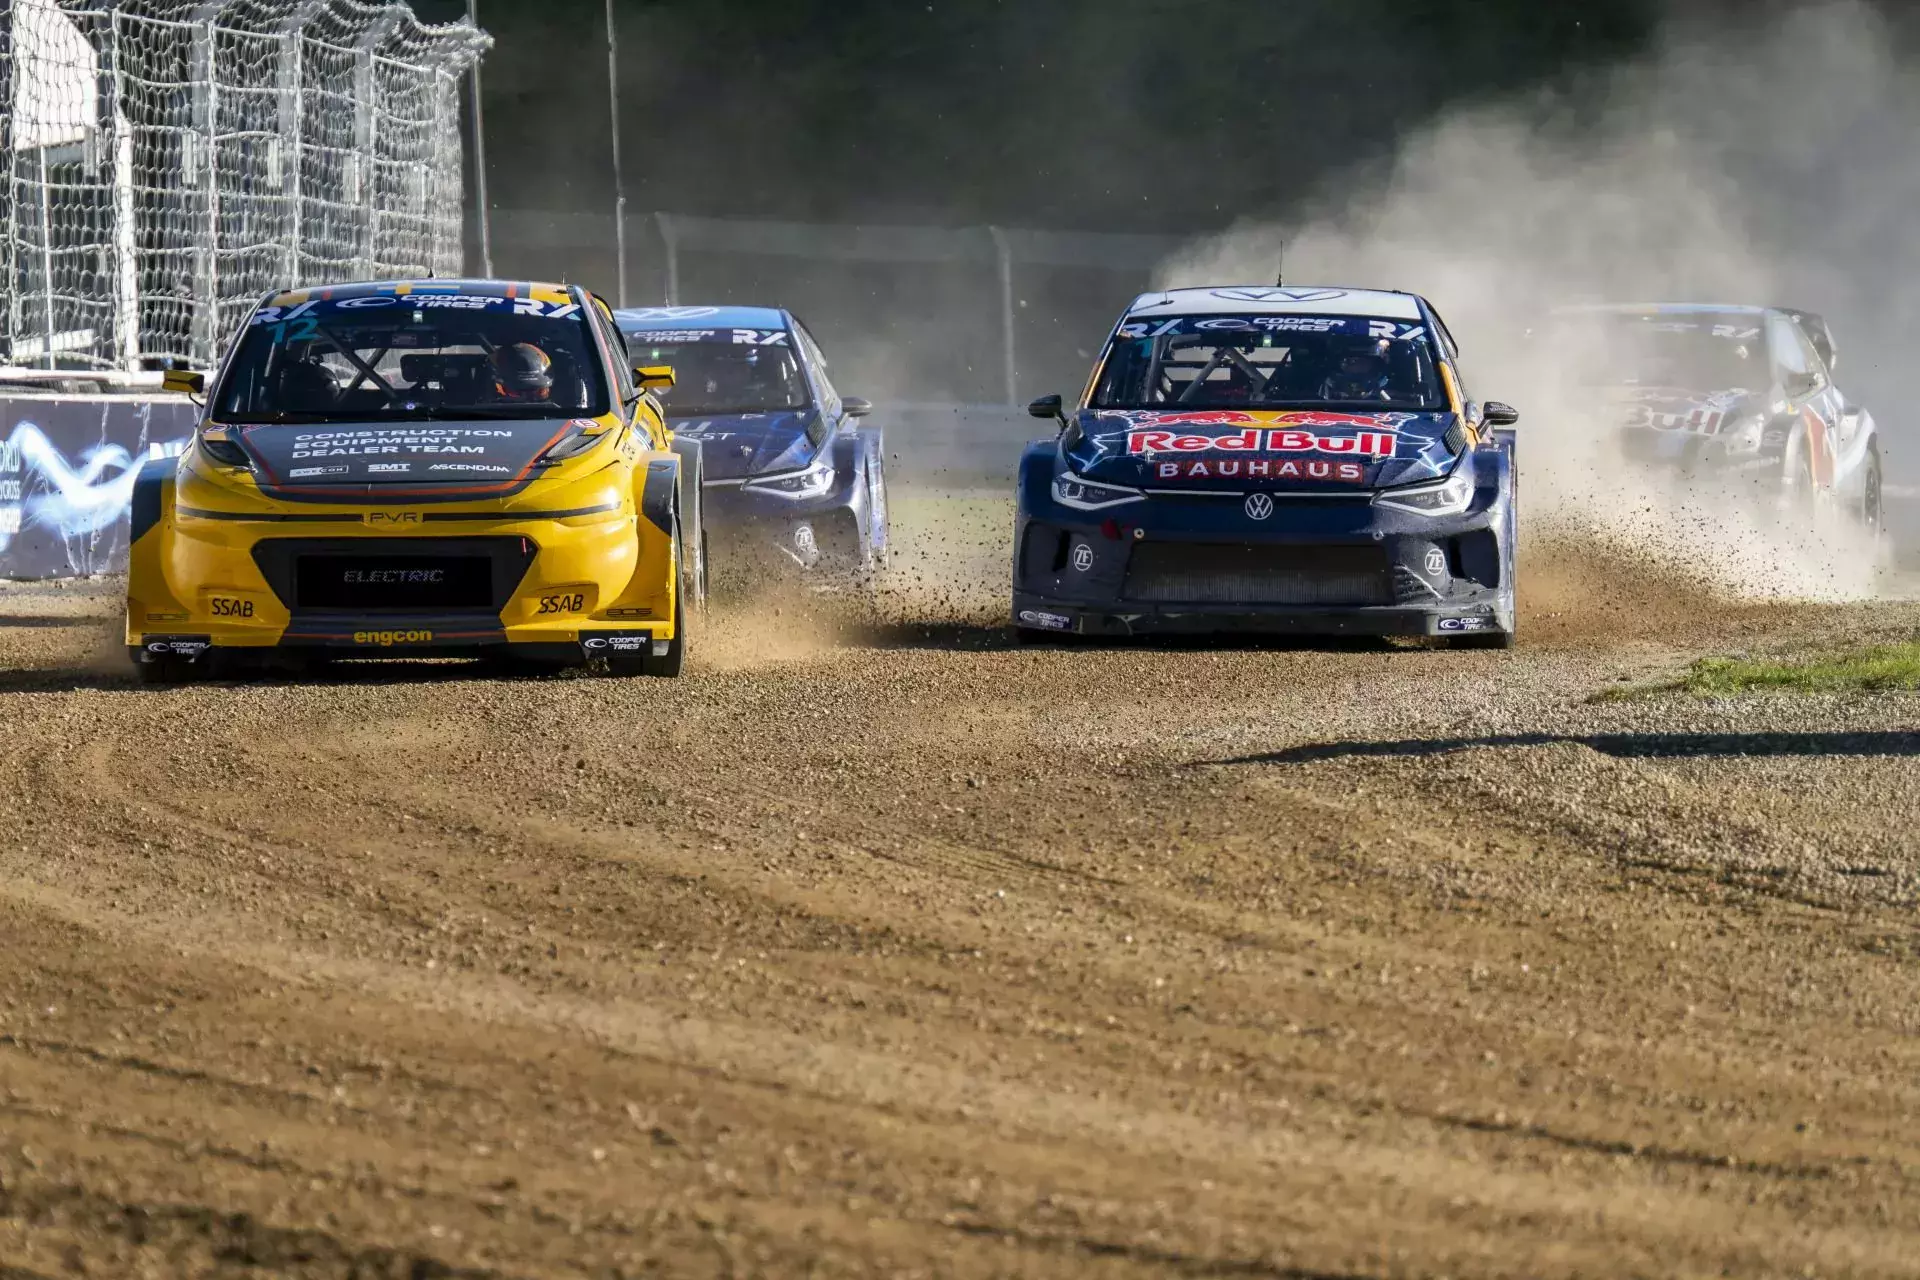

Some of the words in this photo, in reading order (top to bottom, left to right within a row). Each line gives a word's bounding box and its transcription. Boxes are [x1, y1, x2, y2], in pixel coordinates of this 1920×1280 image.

[401, 294, 503, 305] COOPER
[415, 301, 487, 309] TIRES
[513, 297, 581, 321] RX
[1253, 317, 1345, 327] COOPER
[267, 318, 321, 343] 12
[633, 330, 715, 338] COOPER
[1369, 320, 1427, 341] RX
[732, 329, 789, 346] RX
[295, 430, 512, 440] CONSTRUCTION
[293, 437, 458, 449] EQUIPMENT
[1127, 429, 1262, 454] Red
[1266, 430, 1397, 457] Bull
[292, 446, 399, 458] DEALER
[406, 445, 485, 454] TEAM
[368, 463, 411, 472] SMT
[428, 464, 510, 472] ASCENDUM
[1159, 461, 1361, 478] BAUHAUS
[343, 568, 445, 582] ELECTRIC
[211, 598, 254, 617] SSAB
[538, 594, 584, 614] SSAB
[353, 628, 432, 647] engcon
[609, 636, 647, 644] COOPER
[170, 641, 207, 649] COOPER
